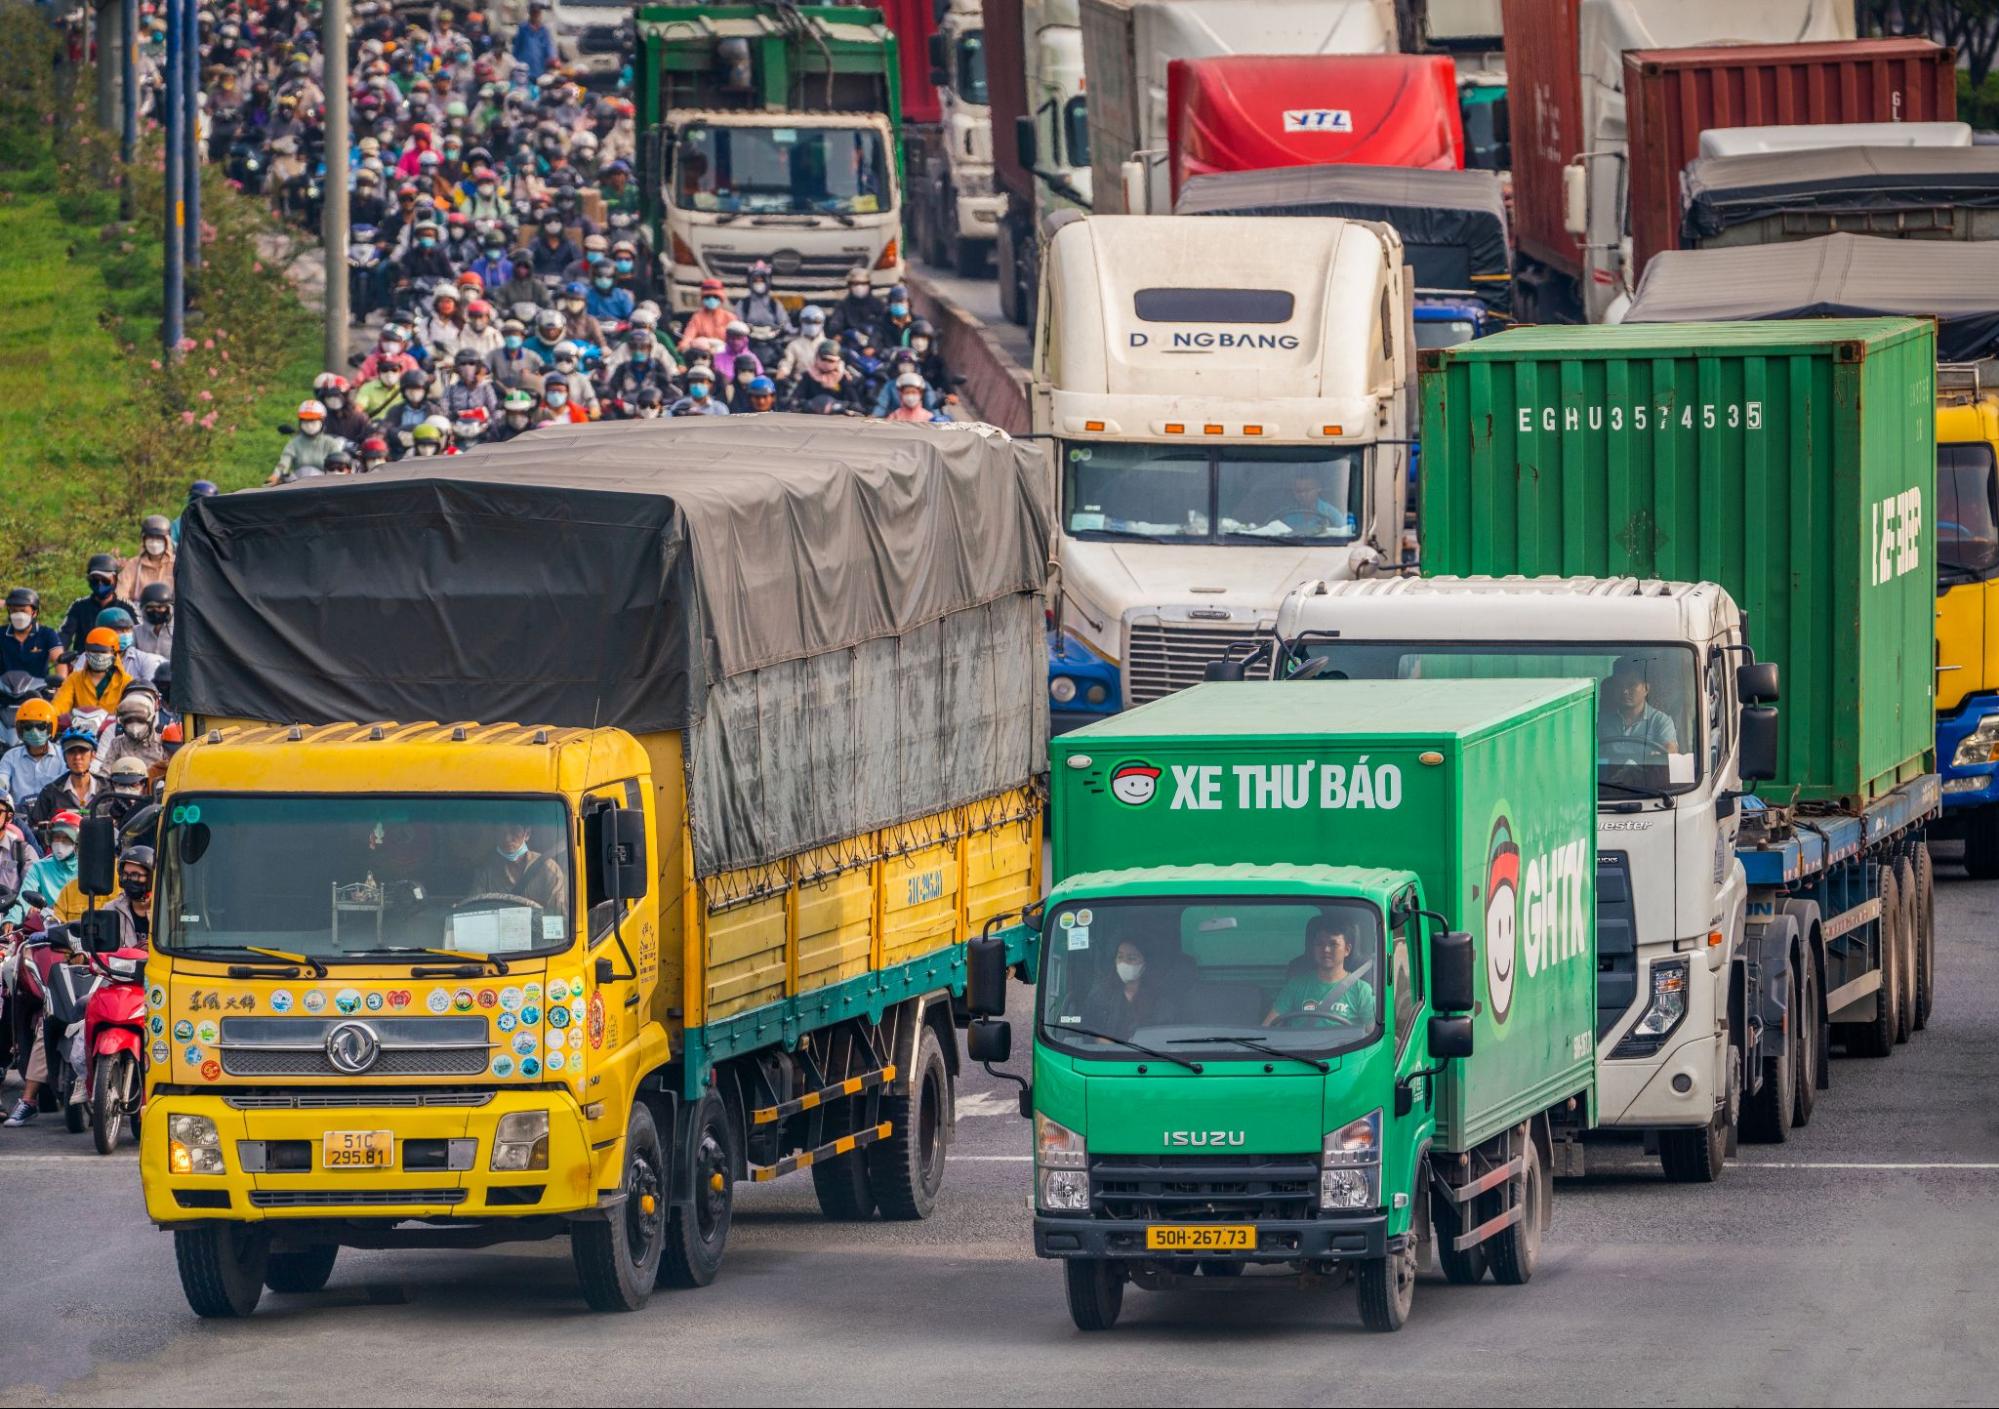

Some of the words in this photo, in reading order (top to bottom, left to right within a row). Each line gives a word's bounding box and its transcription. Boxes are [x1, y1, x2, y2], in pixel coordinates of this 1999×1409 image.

[1129, 332, 1300, 350] DNGBANG
[1170, 765, 1223, 809] XE
[1232, 759, 1316, 809] THƯ
[1320, 754, 1402, 810] BÁO
[1597, 820, 1653, 831] uester
[1523, 838, 1586, 978] GHTK
[344, 1134, 373, 1149] 51C
[1163, 1131, 1245, 1146] ISUZU
[1156, 1230, 1247, 1245] 50H-267.73
